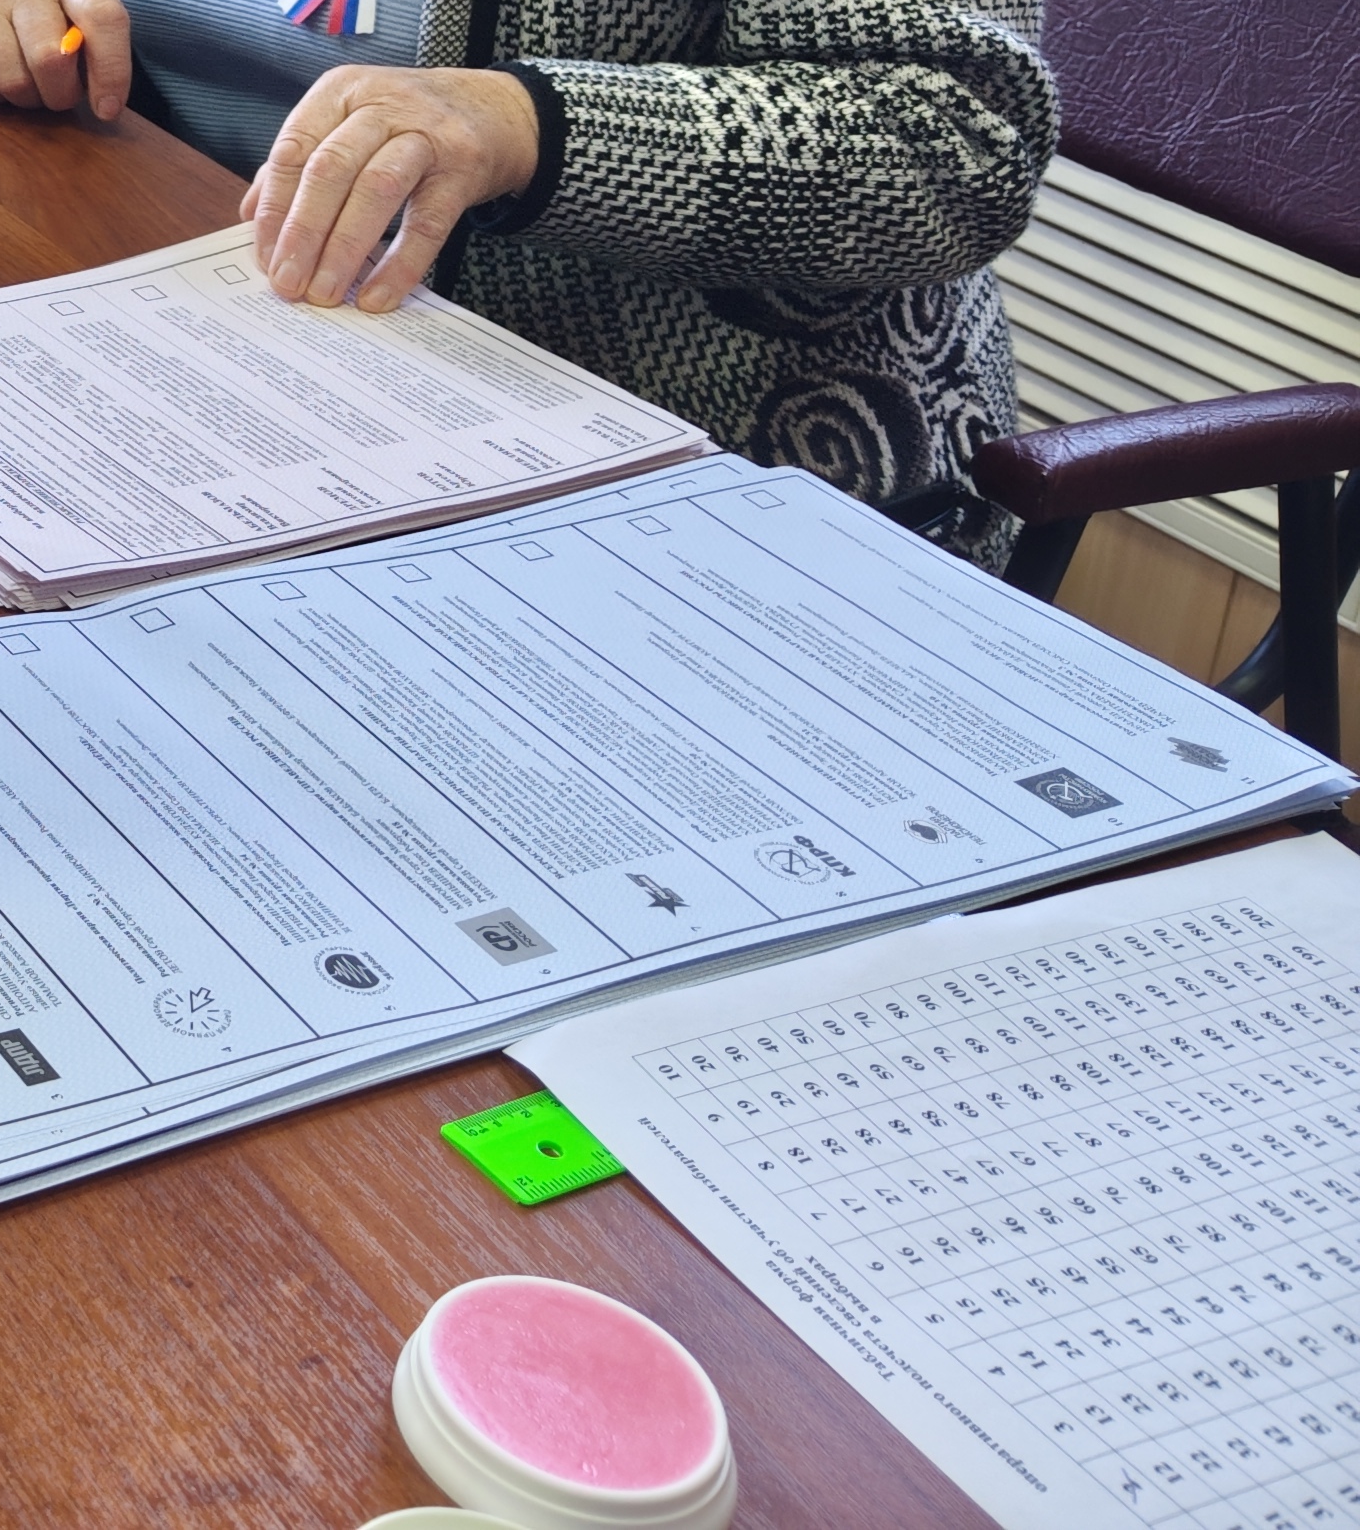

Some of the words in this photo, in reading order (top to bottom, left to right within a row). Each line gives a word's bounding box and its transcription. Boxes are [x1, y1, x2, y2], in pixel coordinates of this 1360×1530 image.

[1240, 776, 1255, 784] 11
[1107, 817, 1123, 826] 10
[792, 834, 856, 877] КПРФ
[1210, 914, 1242, 935] 190
[1239, 907, 1273, 928] 200
[1152, 928, 1184, 949] 170
[1094, 943, 1126, 965] 150
[1035, 958, 1066, 980] 130
[974, 973, 1005, 995] 110
[916, 994, 938, 1010] 90
[853, 1011, 875, 1028] 70
[789, 1028, 814, 1044] 50
[0, 1039, 44, 1075] ЛДПР
[724, 1046, 748, 1062] 30
[691, 1055, 715, 1071] 20
[658, 1064, 680, 1080] 10
[520, 1110, 533, 1118] 2
[736, 1100, 760, 1115] 19
[707, 1113, 722, 1122] 9
[637, 1116, 719, 1192] избирателей
[787, 1147, 811, 1163] 18
[757, 1160, 774, 1170] 8
[840, 1198, 866, 1213] 17
[718, 1195, 780, 1247] участии
[810, 1212, 826, 1220] 7
[774, 1249, 794, 1263] об
[898, 1246, 923, 1264] 16
[868, 1261, 884, 1271] 6
[765, 1259, 813, 1302] форма
[805, 1255, 869, 1312] выборах
[793, 1266, 861, 1327] сведений
[955, 1297, 983, 1315] 15
[869, 1314, 882, 1324] в
[924, 1313, 944, 1323] 5
[813, 1305, 894, 1381] Табличная
[862, 1329, 932, 1390] подсчета
[988, 1366, 1005, 1375] 4
[1053, 1421, 1073, 1432] 3
[933, 1392, 1047, 1492] оперативного
